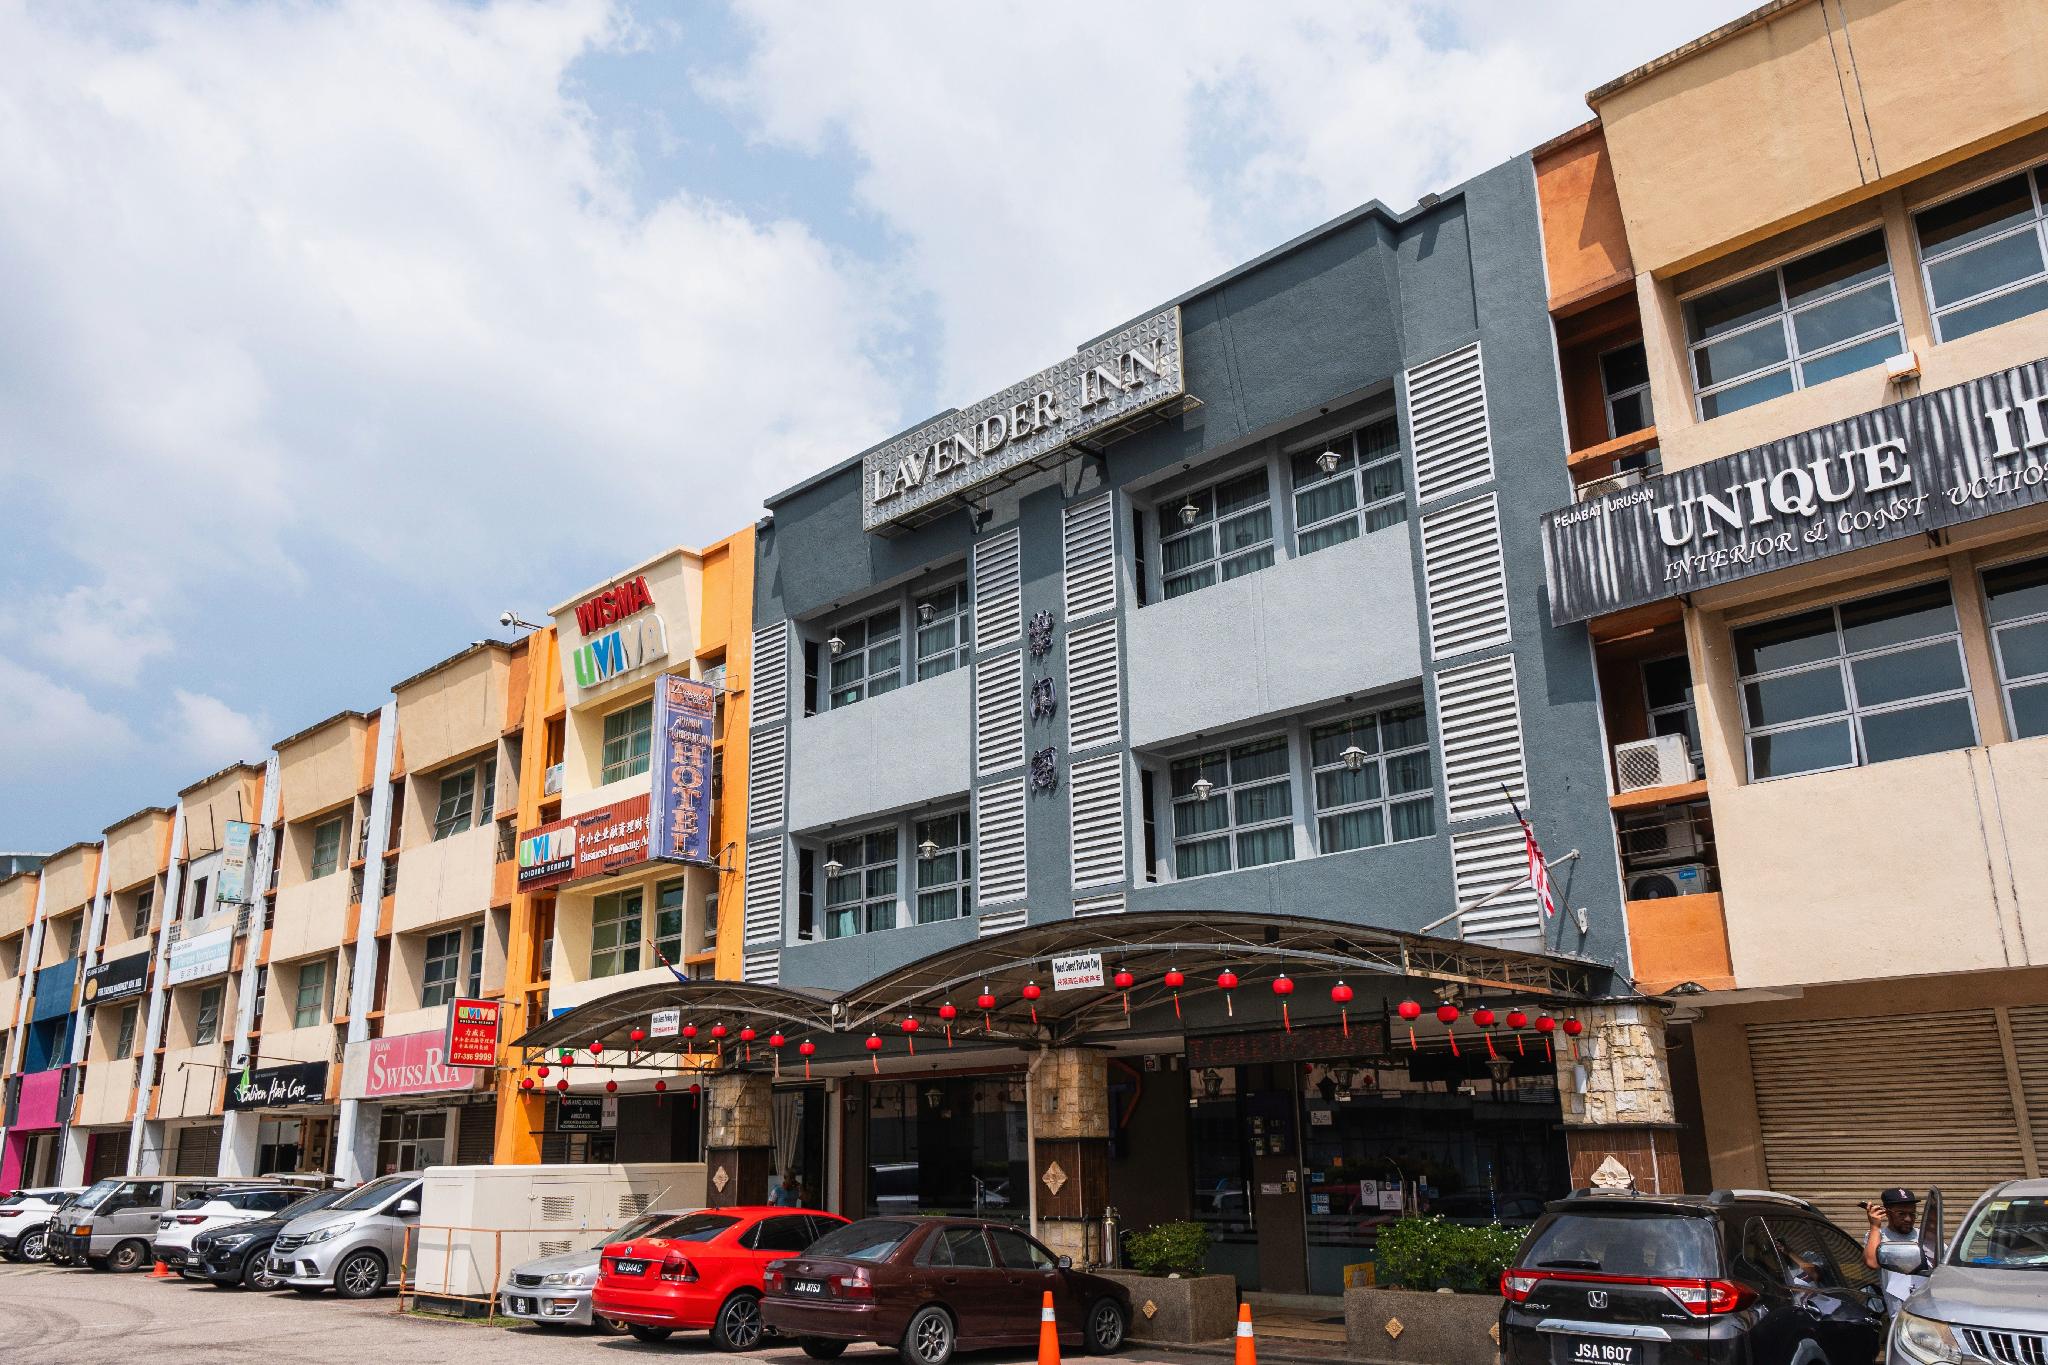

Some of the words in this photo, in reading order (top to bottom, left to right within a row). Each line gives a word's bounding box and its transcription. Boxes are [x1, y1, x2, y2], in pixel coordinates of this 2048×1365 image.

[873, 390, 1061, 503] LAVENDER
[1078, 338, 1162, 411] INN
[1553, 503, 1602, 529] PEJABAT
[1609, 488, 1655, 513] URUSAN
[1653, 436, 1911, 547] UNIQUE
[1663, 532, 1800, 583] INTERIOR
[1803, 519, 1828, 544] &
[574, 575, 655, 637] WISMA
[670, 741, 705, 857] HOTEL
[580, 848, 608, 863] Business
[608, 838, 641, 855] Financing
[1575, 1343, 1600, 1360] JSA
[1602, 1345, 1632, 1362] 1607
